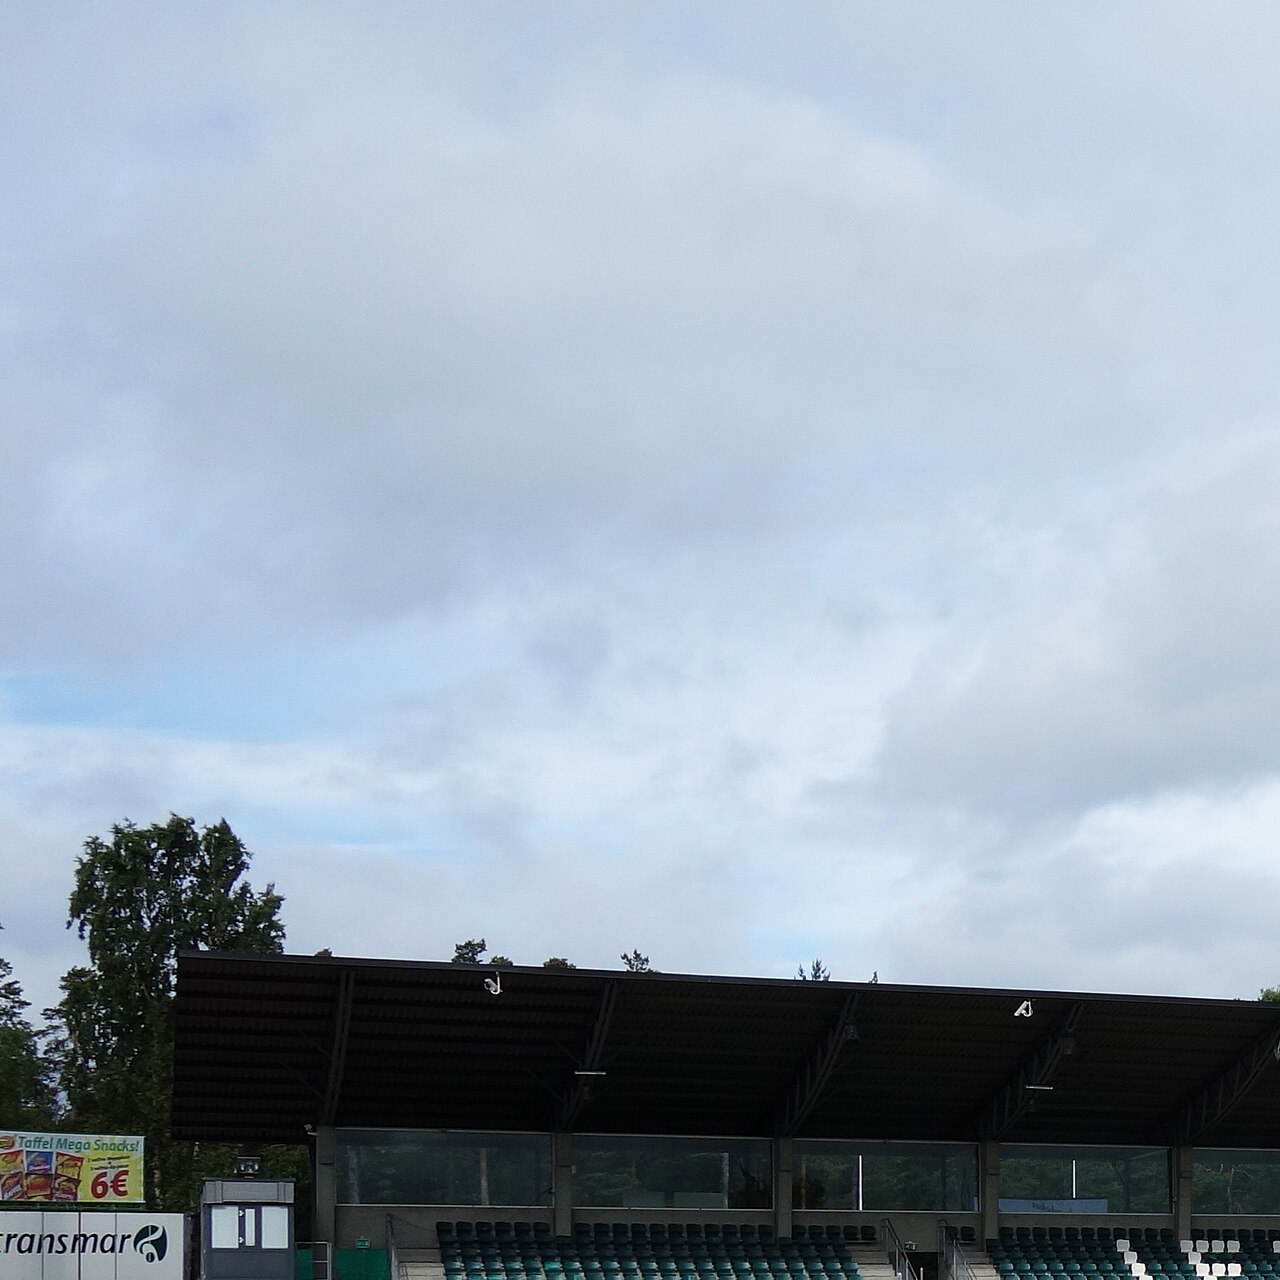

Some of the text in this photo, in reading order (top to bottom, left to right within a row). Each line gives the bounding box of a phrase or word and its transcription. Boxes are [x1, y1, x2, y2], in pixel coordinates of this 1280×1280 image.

[18, 1136, 140, 1153] Taffel Mega Snacks!
[91, 1169, 130, 1199] 6€
